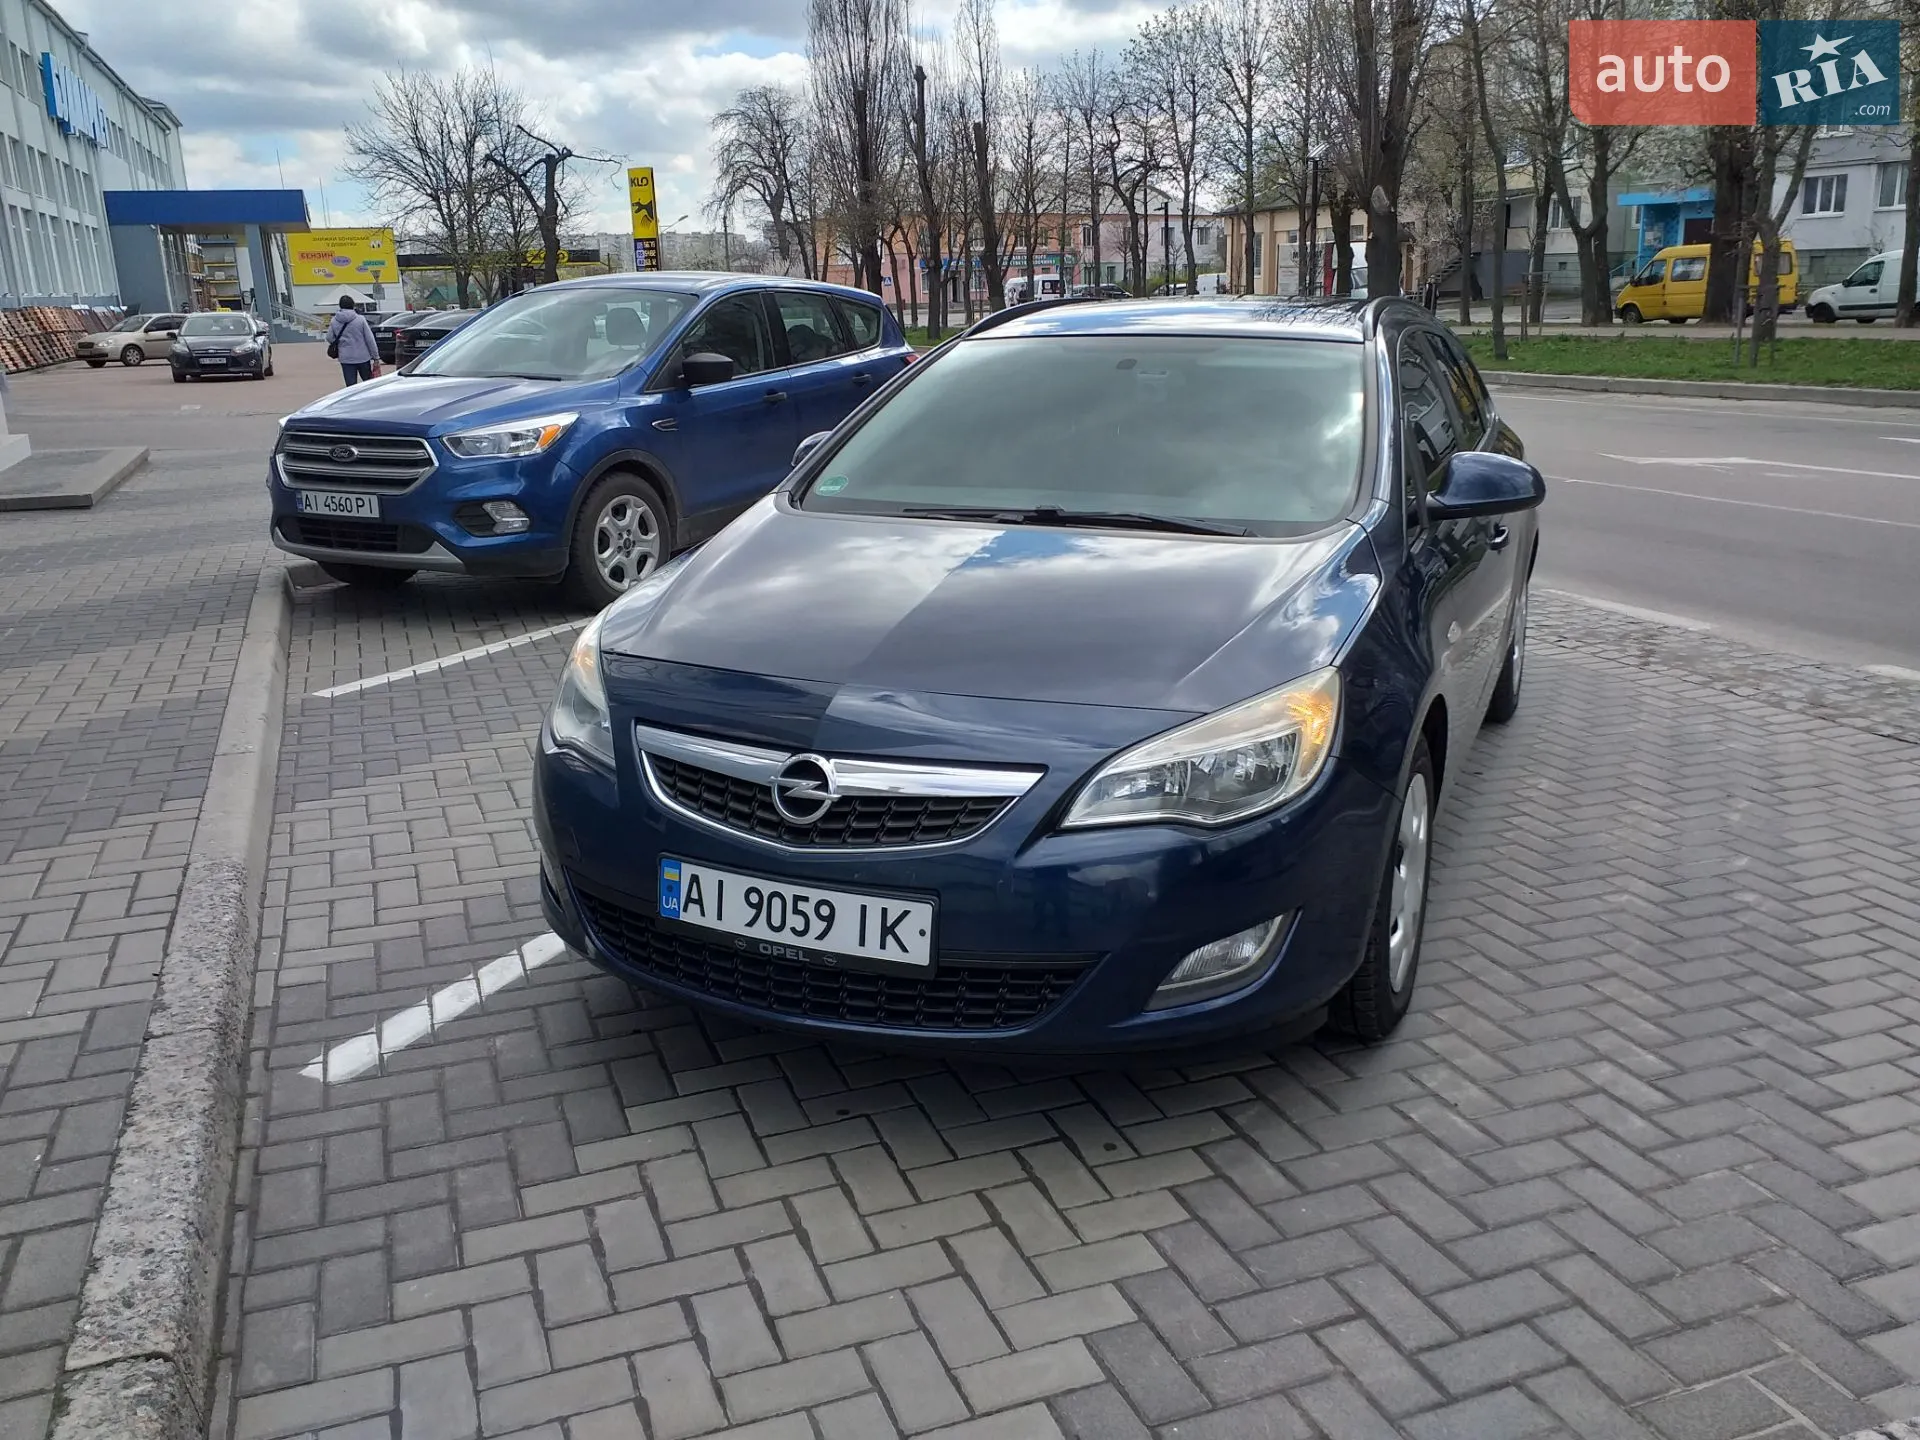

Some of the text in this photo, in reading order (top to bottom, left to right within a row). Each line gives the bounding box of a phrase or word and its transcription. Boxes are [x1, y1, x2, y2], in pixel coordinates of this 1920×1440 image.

[300, 251, 334, 260] БЕНЗИН
[304, 493, 373, 514] AI 4560 PI
[662, 895, 679, 911] UA
[682, 873, 911, 953] AI 9059 IK
[758, 942, 810, 962] OPEL
